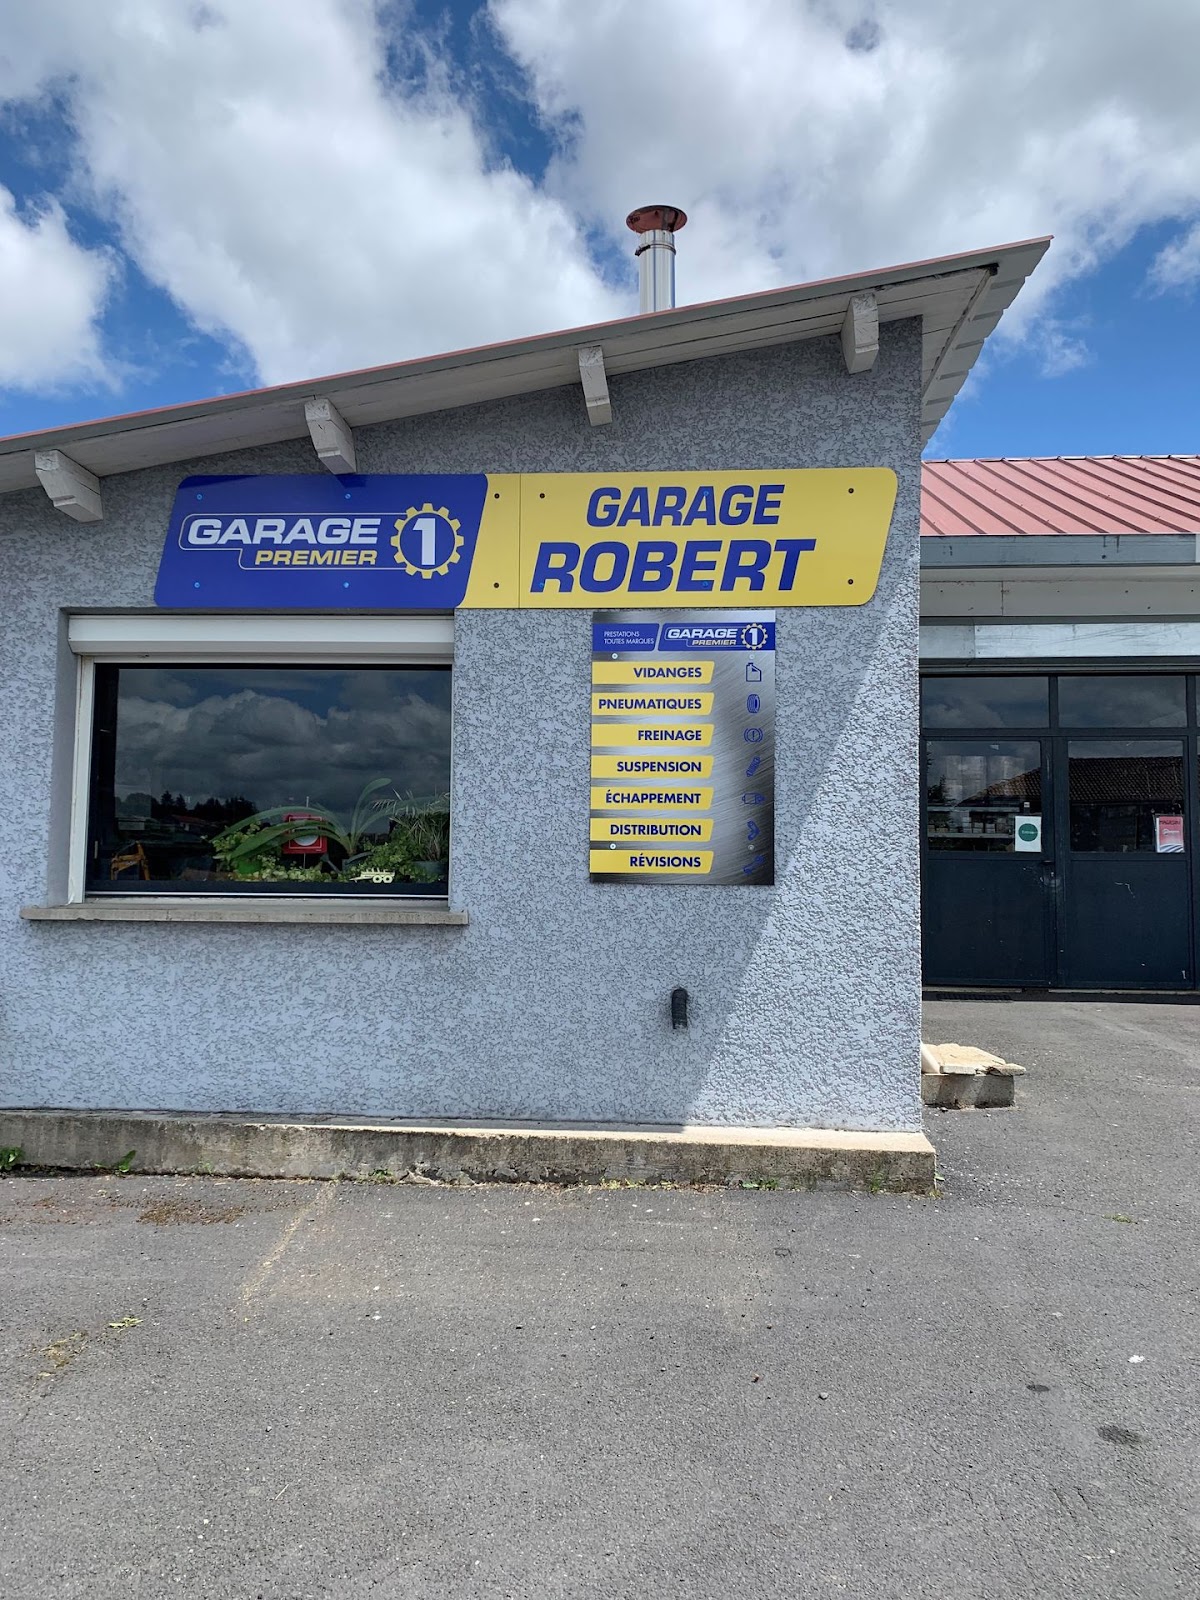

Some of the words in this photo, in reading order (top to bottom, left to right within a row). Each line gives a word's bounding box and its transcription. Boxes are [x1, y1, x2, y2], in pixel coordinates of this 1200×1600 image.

[586, 484, 785, 527] GARAGE
[187, 518, 382, 545] GARAGE
[412, 517, 436, 566] 1
[254, 549, 378, 566] PREMIER
[530, 538, 817, 593] ROBERT
[603, 630, 640, 638] PRESTATIONS
[667, 628, 738, 639] GARAGE
[748, 627, 758, 646] 1
[625, 637, 655, 645] MARQUES
[633, 667, 702, 678] VIDANGES
[598, 698, 702, 710] PNEUMATIQUES
[637, 729, 702, 741] FREINAGE
[616, 761, 702, 772] SUSPENSION
[605, 789, 701, 804] ÉCHAPPEMENT
[610, 824, 702, 836] DISTRIBUTION
[629, 852, 701, 868] RÉVISIONS
